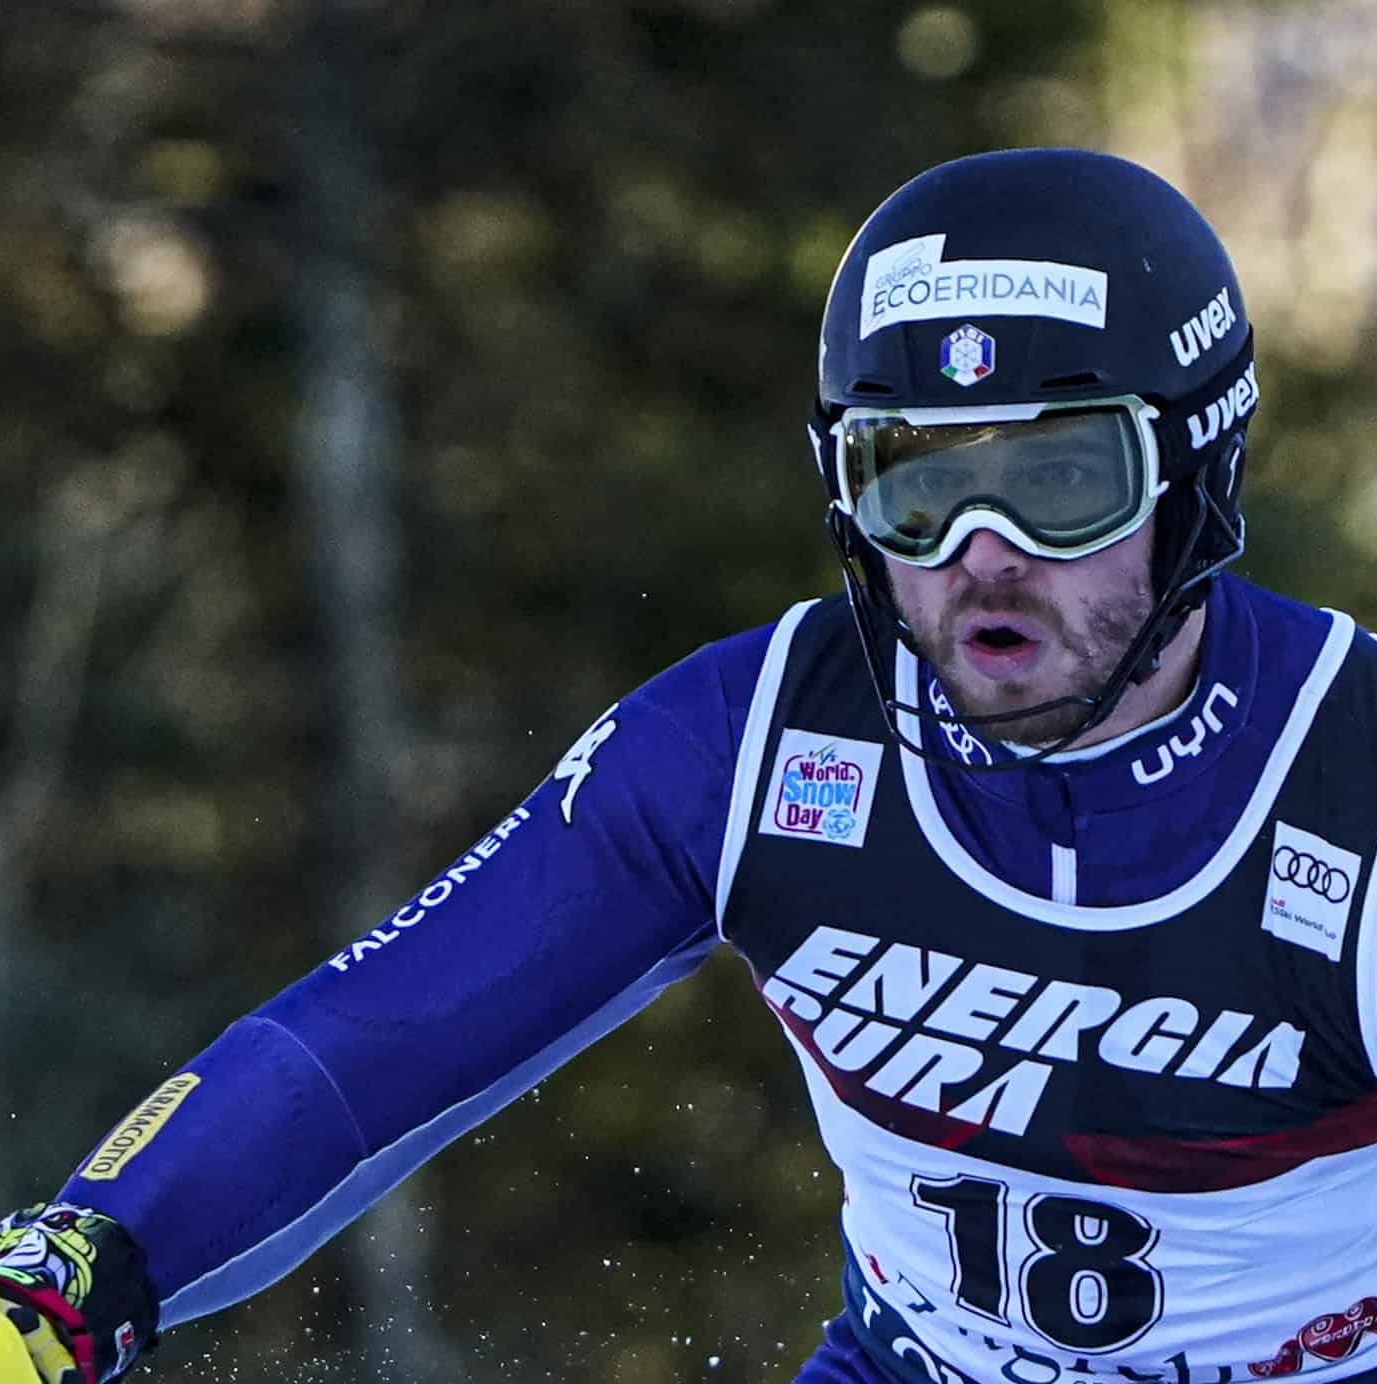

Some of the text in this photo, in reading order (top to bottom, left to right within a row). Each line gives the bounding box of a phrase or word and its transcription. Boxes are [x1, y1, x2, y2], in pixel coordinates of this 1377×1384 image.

[872, 273, 1102, 316] ECOERIDANIA
[1170, 287, 1236, 367] uvex
[1187, 361, 1259, 449] uvex
[784, 771, 856, 807] Snow
[787, 804, 823, 829] Day
[328, 807, 530, 971] FALCONERI
[775, 926, 1306, 1088] ENERGIA
[92, 1080, 191, 1173] PARMACOTTO
[910, 1174, 1164, 1353] 18
